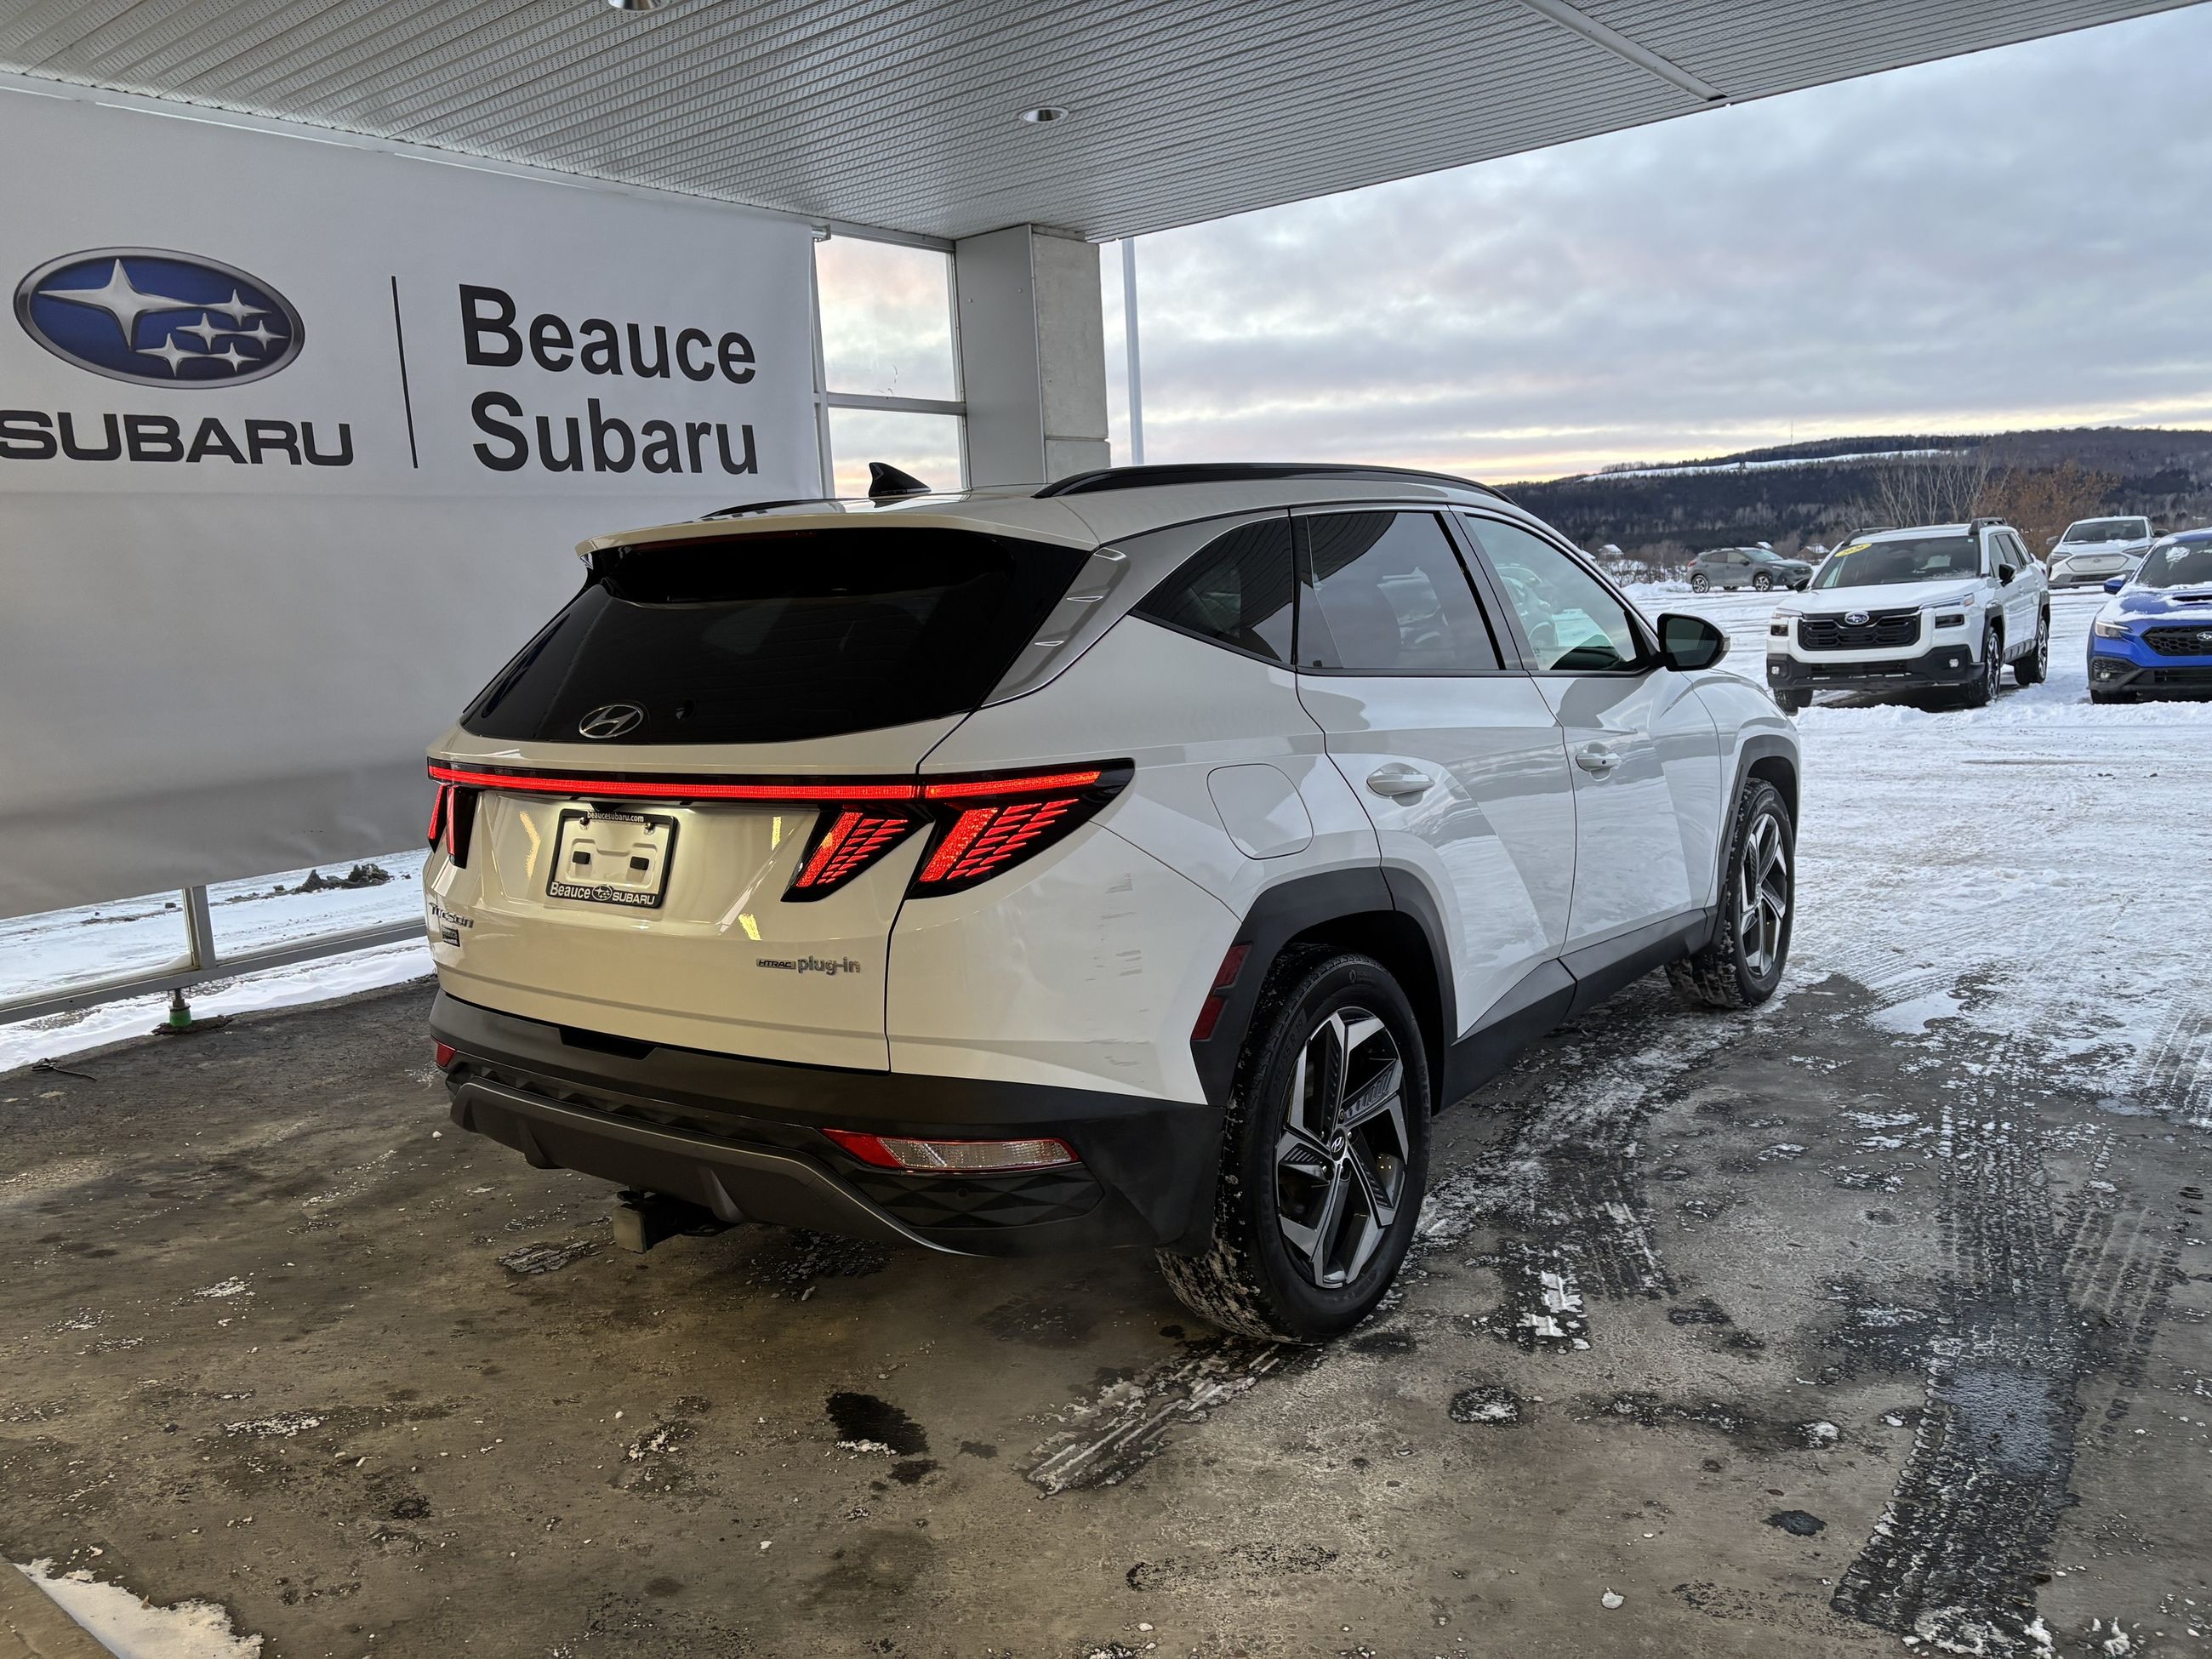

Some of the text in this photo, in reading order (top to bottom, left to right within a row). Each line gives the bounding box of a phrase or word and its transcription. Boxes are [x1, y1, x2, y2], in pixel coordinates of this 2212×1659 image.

[459, 284, 756, 385] Beauce
[0, 410, 354, 466] SUBARU
[471, 391, 758, 475] Subaru
[587, 811, 644, 823] beaucesubaru.com
[550, 881, 655, 905] Beauce SUBARU
[759, 955, 861, 976] HTRAC plug-in
